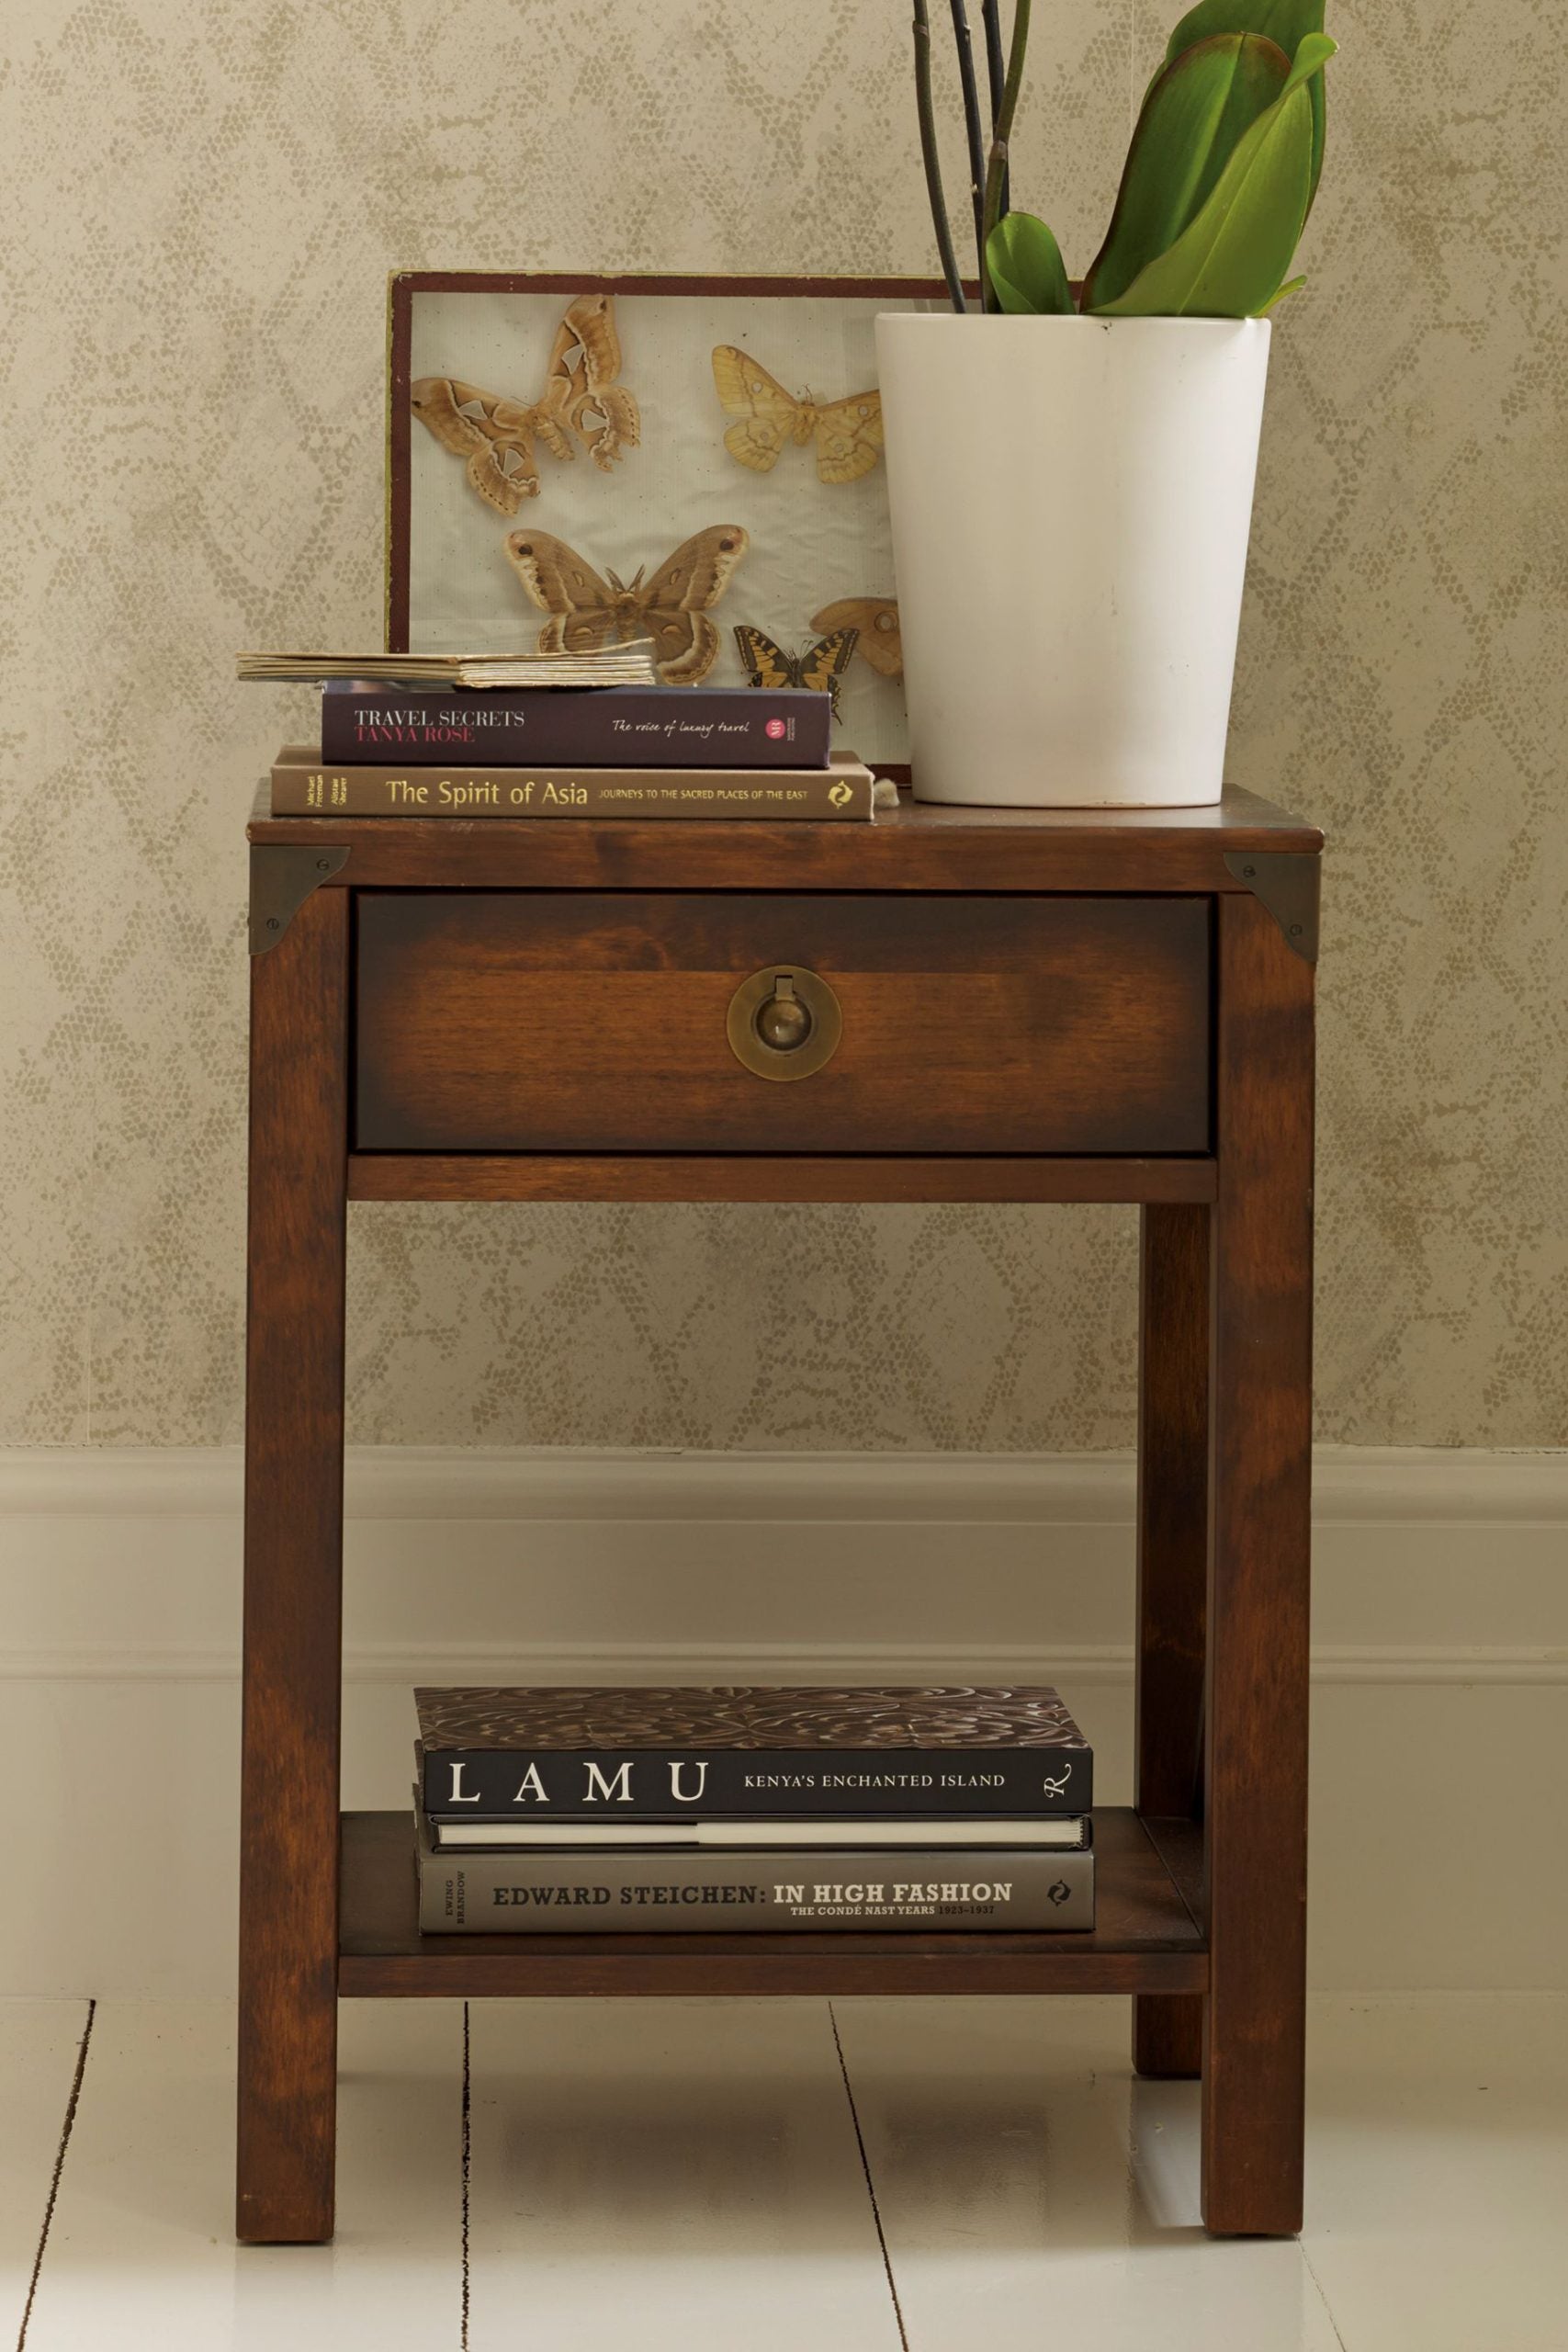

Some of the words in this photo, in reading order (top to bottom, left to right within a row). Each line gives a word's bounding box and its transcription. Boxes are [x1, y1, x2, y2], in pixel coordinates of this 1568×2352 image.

[355, 710, 434, 726] TRAVEL
[439, 711, 525, 727] SECRETS
[612, 719, 632, 731] The
[636, 722, 660, 731] voice
[664, 719, 677, 737] of
[680, 720, 715, 739] luxury
[718, 721, 750, 732] travel
[355, 727, 418, 742] TANYA
[424, 727, 476, 742] ROSE
[307, 775, 315, 806] Michael
[315, 775, 323, 808] Freeman
[386, 781, 428, 803] The
[439, 781, 500, 808] Spirit
[510, 782, 535, 805] of
[542, 782, 588, 805] Asia
[599, 789, 643, 799] JOURNEYS
[646, 789, 658, 799] TO
[660, 789, 678, 799] THE
[681, 789, 714, 799] SACRED
[717, 789, 749, 799] PLACES
[751, 789, 763, 799] OF
[766, 789, 784, 799] THE
[786, 789, 808, 799] EAST
[448, 1762, 709, 1802] LAMU
[745, 1775, 815, 1788] KENYA'S
[822, 1775, 933, 1787] ENCHANTED
[941, 1774, 1006, 1787] ISLAND
[446, 1880, 454, 1916] EWING
[457, 1871, 466, 1924] BRANDOW
[493, 1888, 611, 1905] EDWARD
[620, 1886, 766, 1905] STEICHEN:
[773, 1885, 805, 1904] IN
[813, 1884, 885, 1904] HIGH
[893, 1883, 1012, 1903] FASHION
[791, 1906, 815, 1916] THE
[818, 1905, 862, 1916] CONDÉ
[865, 1906, 895, 1915] NAST
[897, 1906, 935, 1915] YEARS
